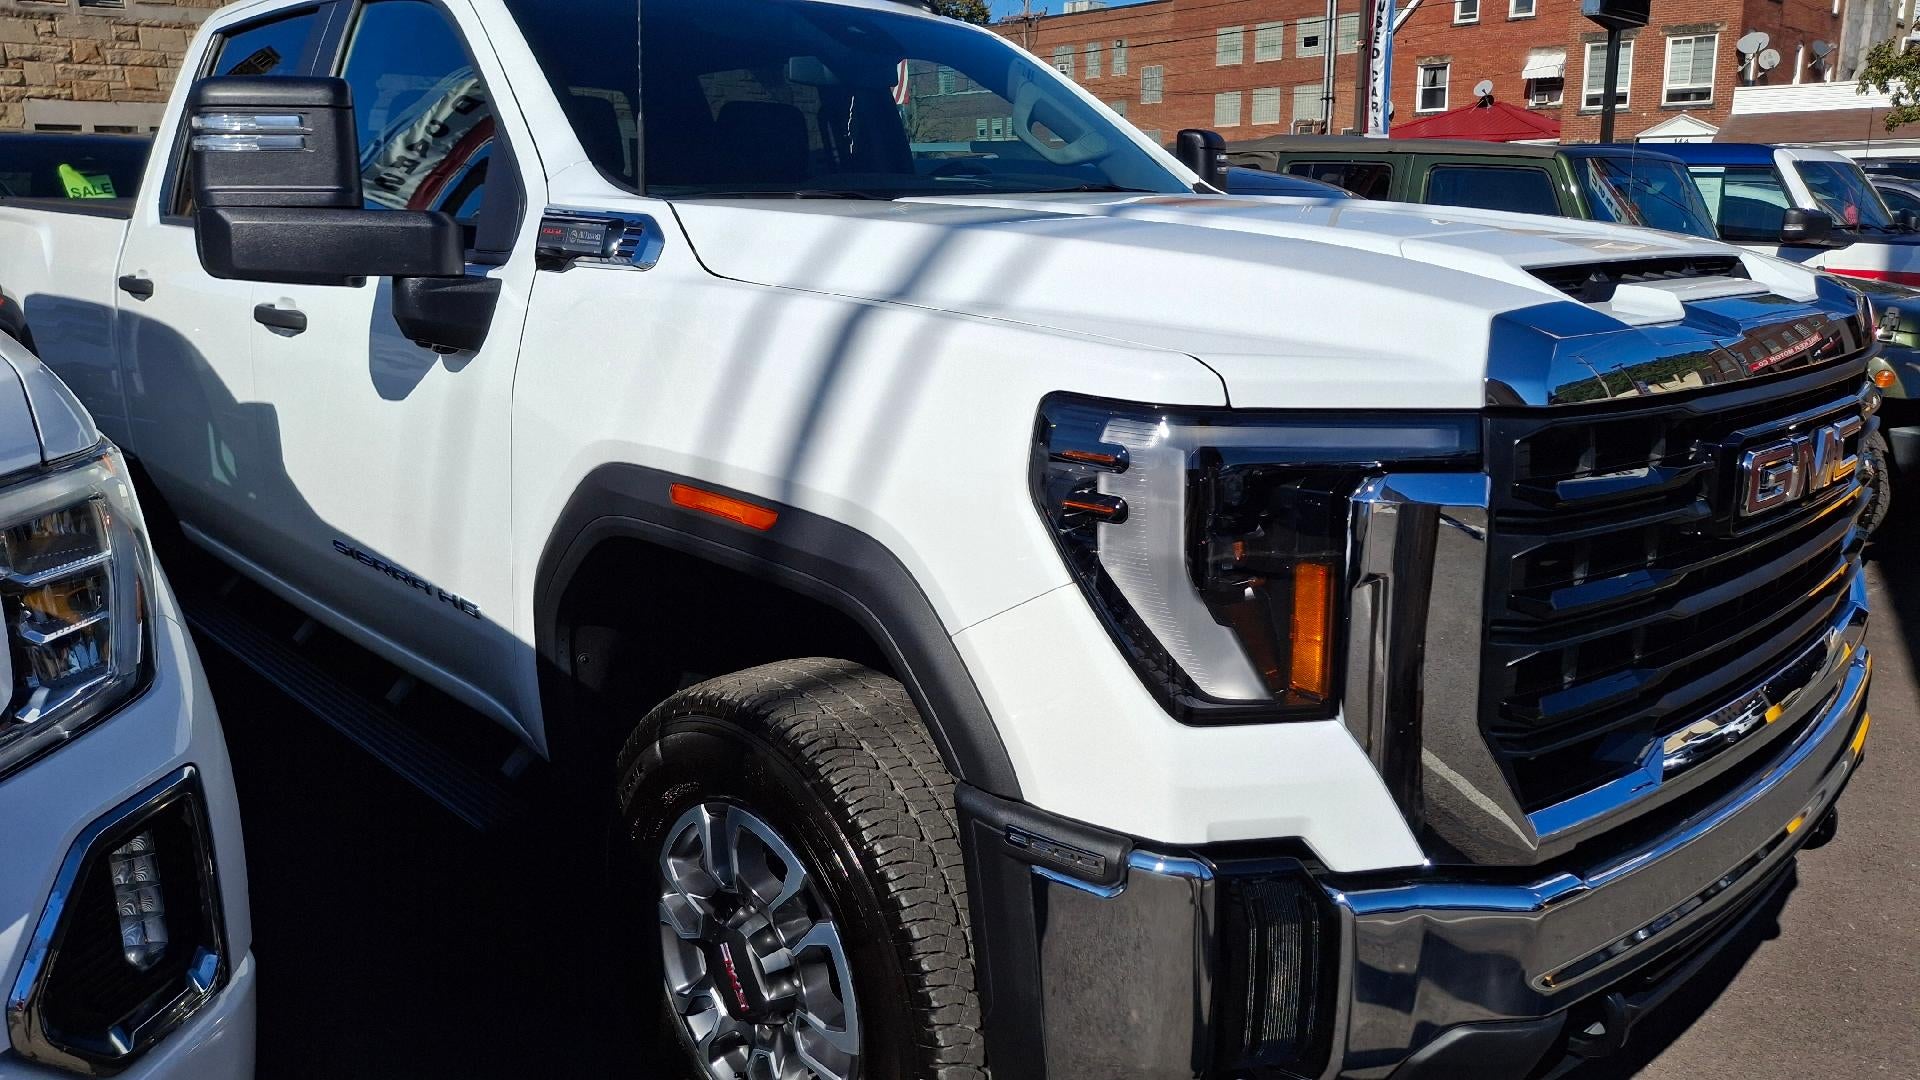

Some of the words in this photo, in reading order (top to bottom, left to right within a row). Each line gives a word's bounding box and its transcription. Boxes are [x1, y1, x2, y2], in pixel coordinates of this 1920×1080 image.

[1371, 0, 1386, 60] USED
[1371, 70, 1380, 128] CARS
[70, 182, 113, 198] SALE
[1741, 415, 1861, 516] GMC
[332, 539, 432, 596] SIERRA
